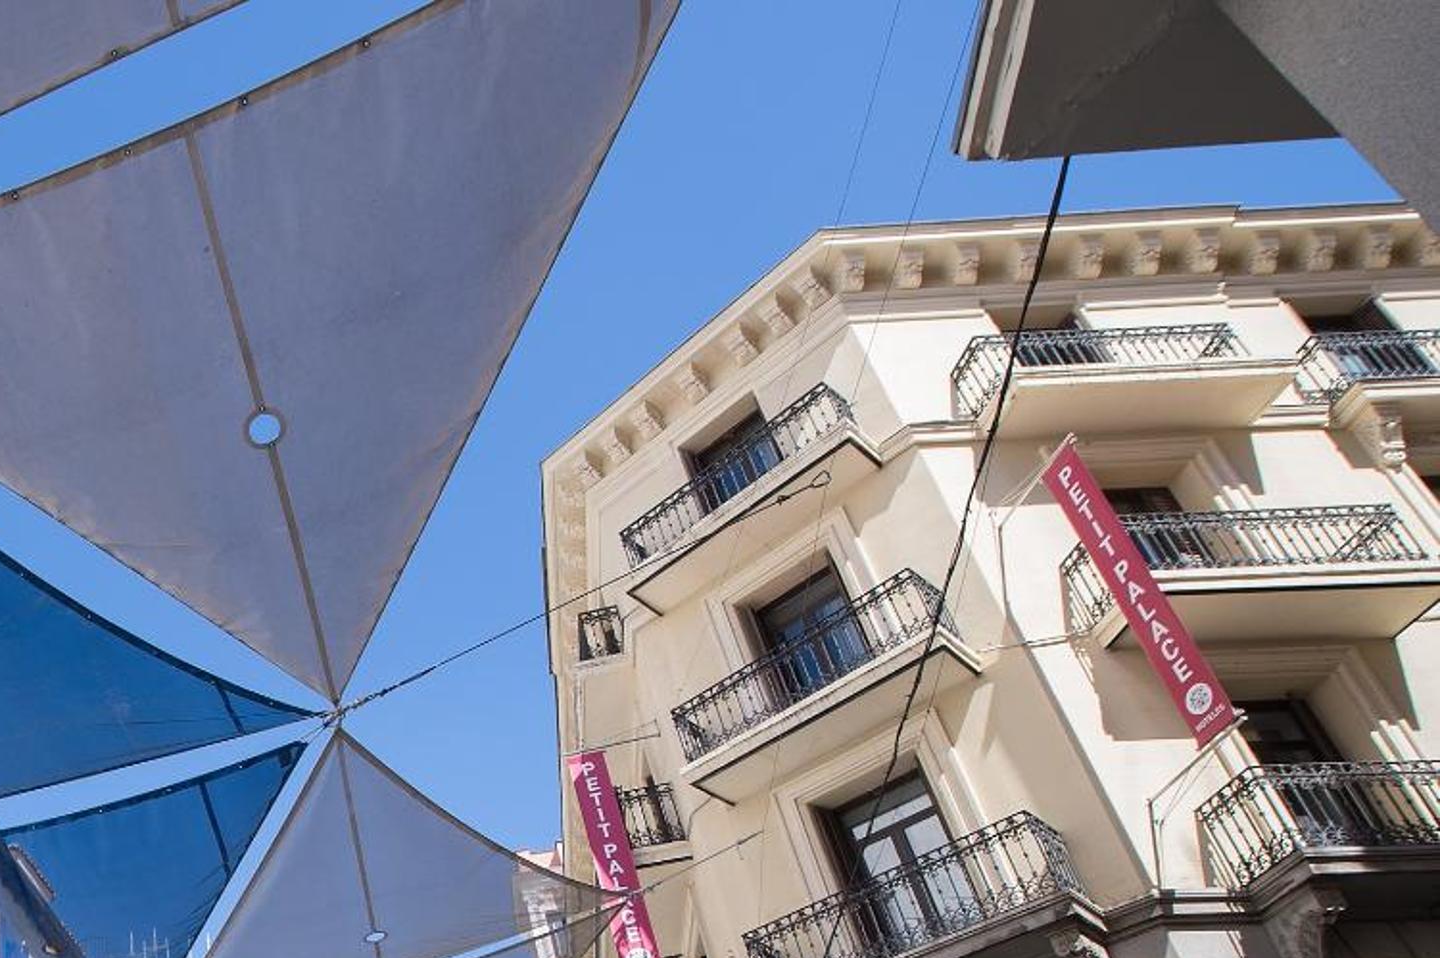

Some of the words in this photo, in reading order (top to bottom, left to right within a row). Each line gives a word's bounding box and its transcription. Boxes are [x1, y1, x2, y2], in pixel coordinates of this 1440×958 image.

[1058, 465, 1115, 558] PETIT
[1113, 560, 1194, 684] PALACE
[581, 762, 611, 839] PETIT
